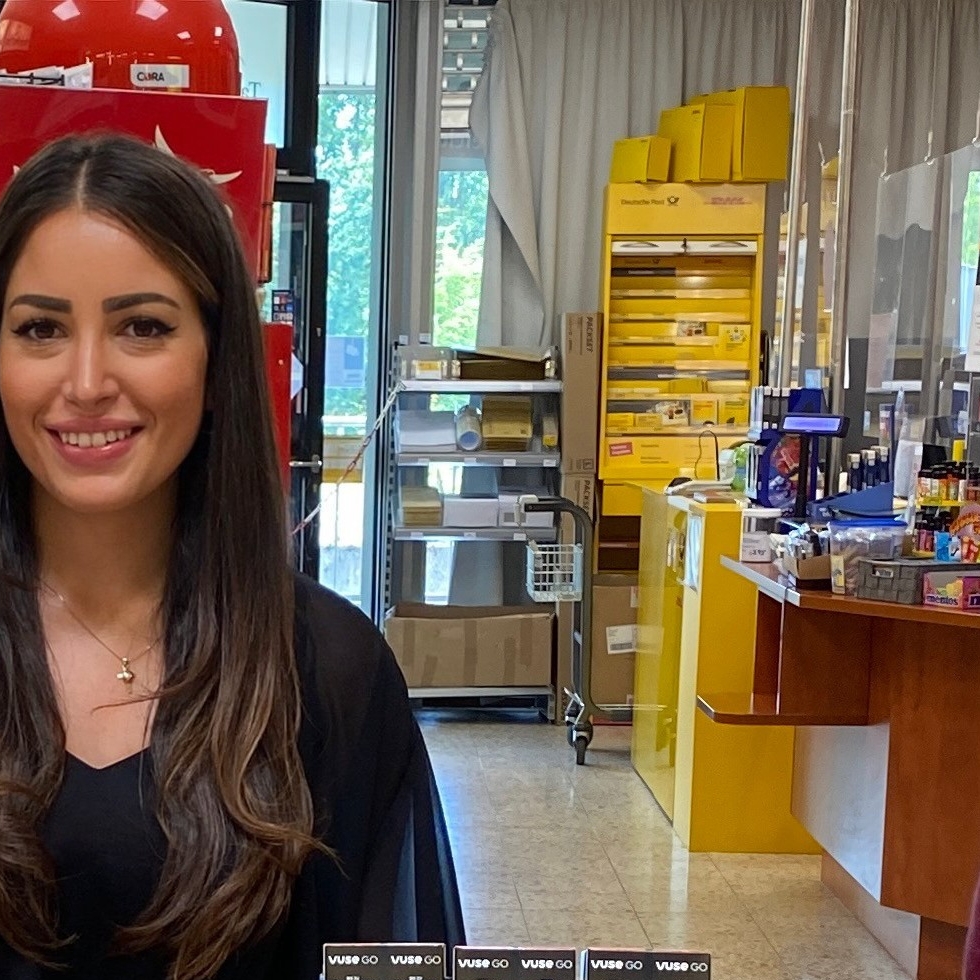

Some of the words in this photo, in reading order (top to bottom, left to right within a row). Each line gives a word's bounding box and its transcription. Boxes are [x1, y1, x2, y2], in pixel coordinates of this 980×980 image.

[585, 316, 594, 353] PACKSET
[361, 955, 379, 965] GO
[424, 955, 442, 965] GO
[491, 958, 509, 969] GO
[555, 959, 573, 969] GO
[625, 960, 643, 970] GO
[690, 962, 708, 972] GO
